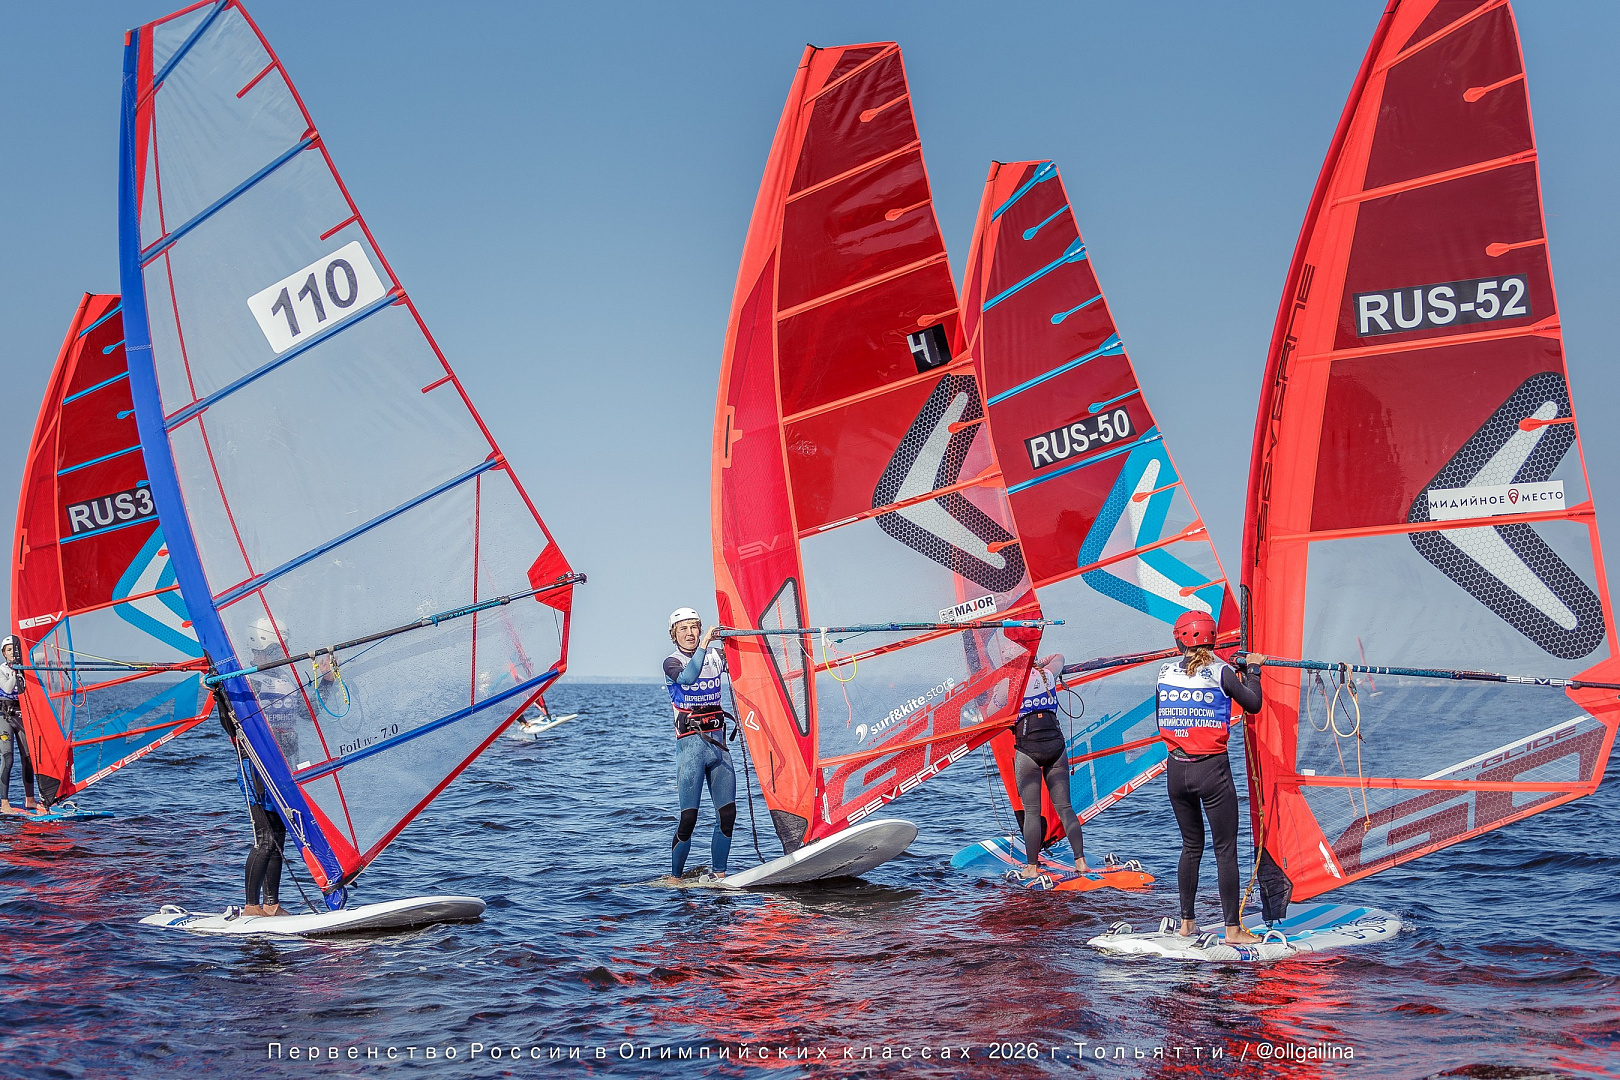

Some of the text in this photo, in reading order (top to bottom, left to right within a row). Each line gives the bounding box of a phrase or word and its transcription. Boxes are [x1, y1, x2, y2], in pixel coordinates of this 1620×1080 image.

[271, 258, 359, 338] 110
[1358, 277, 1527, 335] RUS-52
[1030, 409, 1130, 468] RUS-50
[68, 488, 154, 533] RUS3
[1429, 491, 1564, 509] МИДИЙНОЕ МЕСТО
[954, 596, 995, 617] MAJOR
[870, 677, 955, 735] surf&kite.store
[1174, 728, 1189, 738] 2026
[85, 731, 175, 786] SEVERNE
[339, 738, 361, 756] Foil
[381, 723, 399, 739] 7.0
[1481, 725, 1577, 769] GLIDE
[846, 743, 970, 826] SEVERNE
[1080, 757, 1168, 823] SEVER
[1370, 811, 1525, 873] SEVERNE
